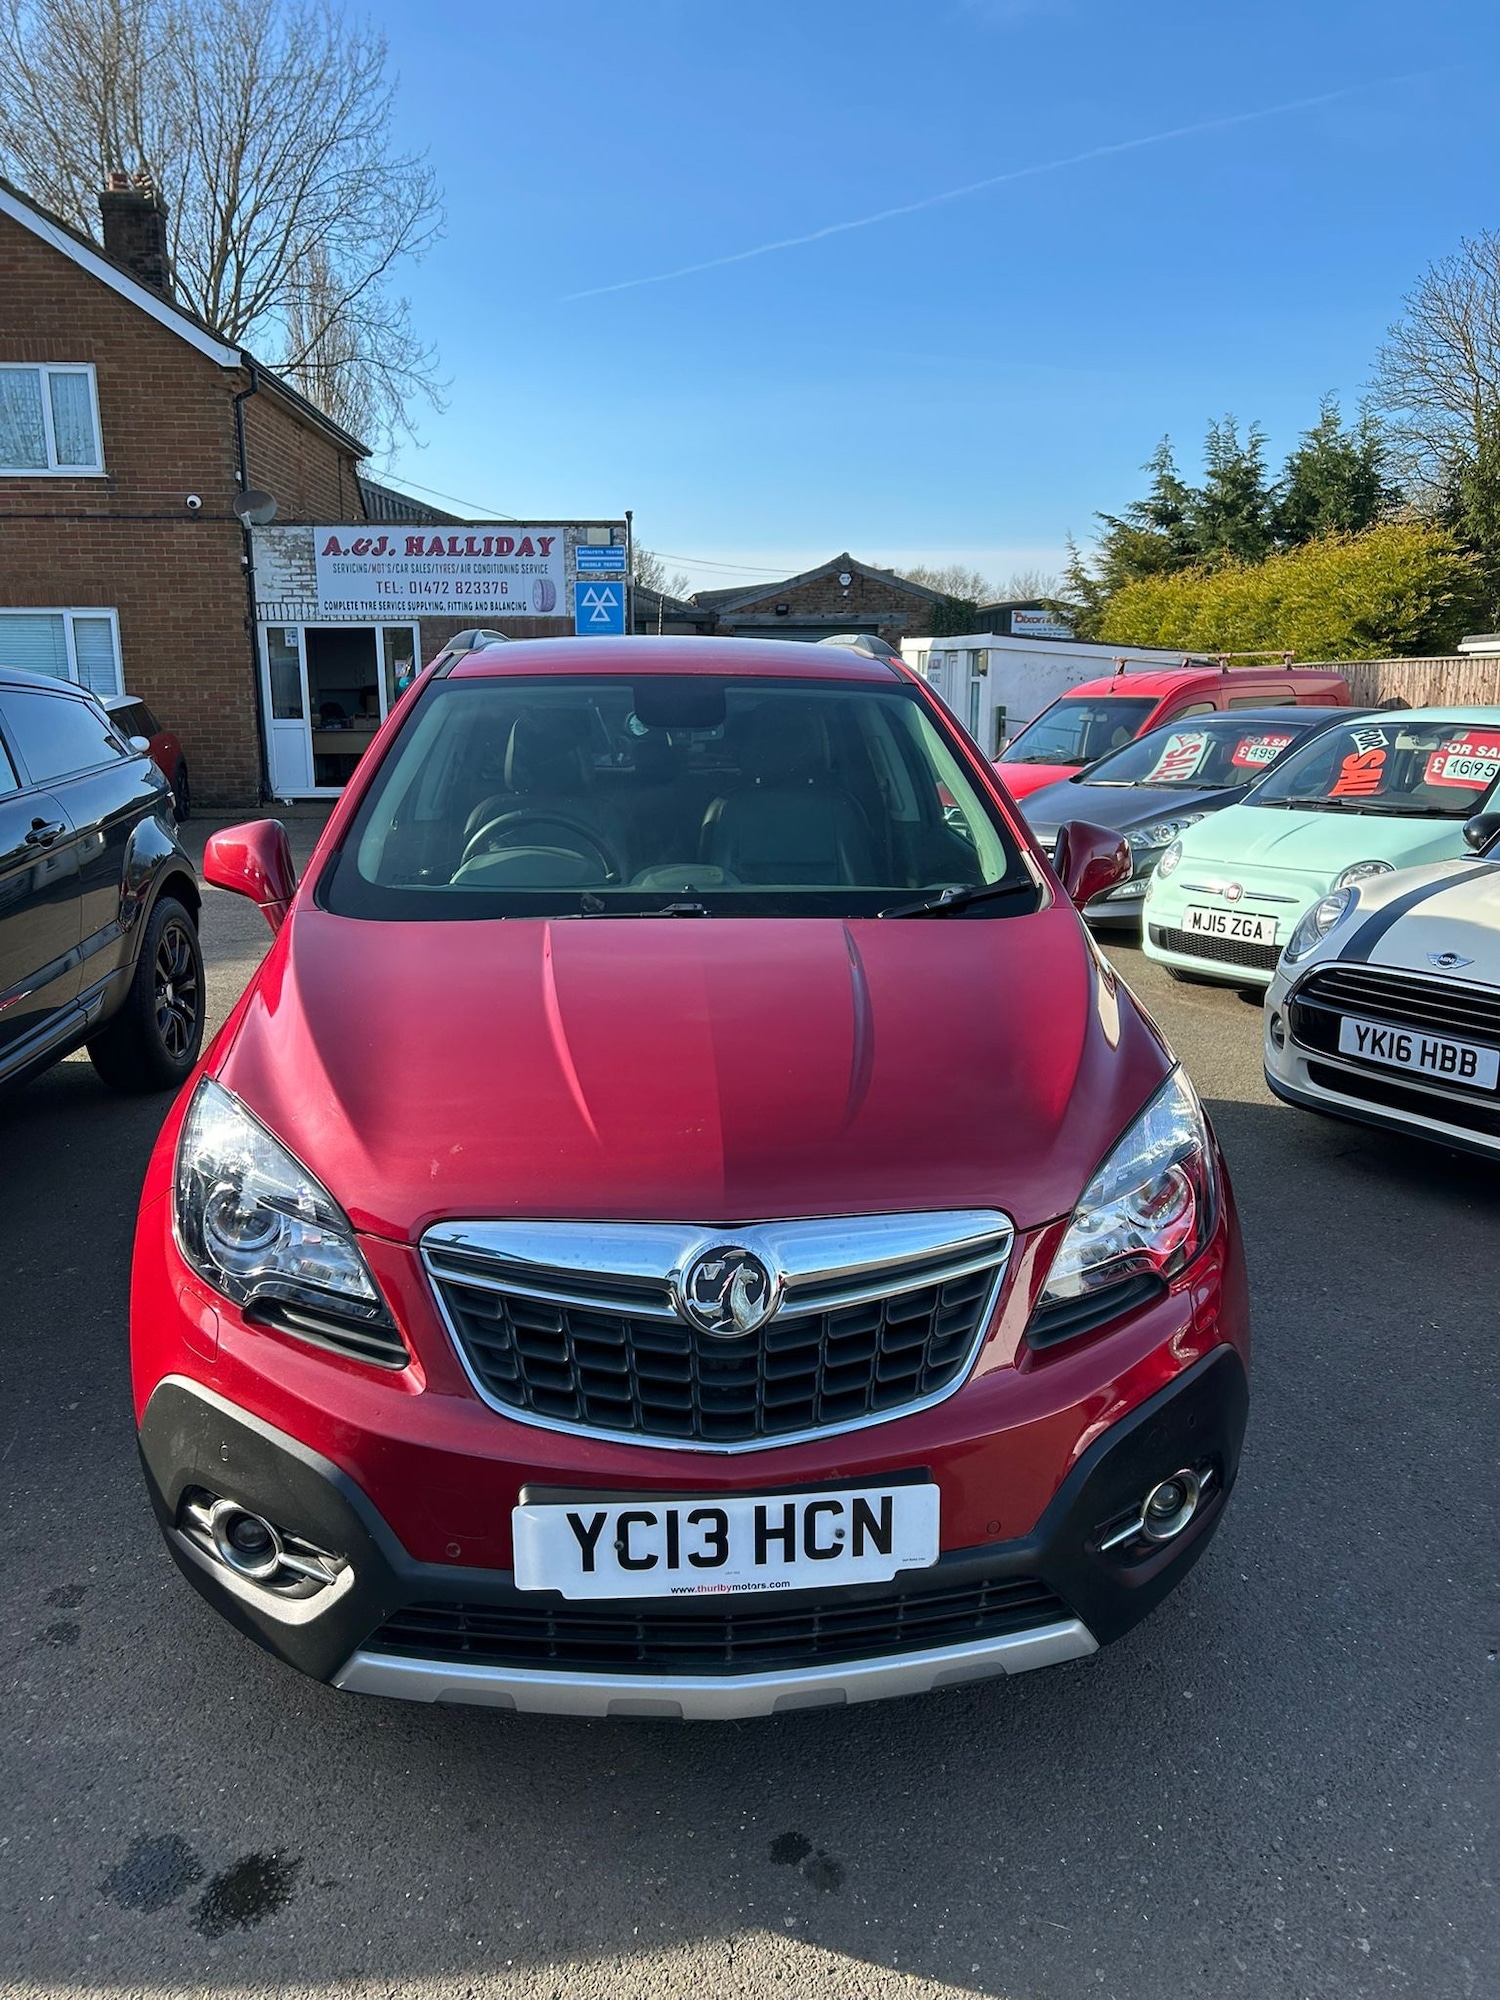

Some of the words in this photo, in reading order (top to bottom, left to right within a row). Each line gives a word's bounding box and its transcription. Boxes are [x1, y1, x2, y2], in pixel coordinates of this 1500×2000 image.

[404, 535, 556, 557] HALLIDAY
[473, 563, 520, 574] CONDITIONING
[521, 563, 549, 574] SERVICE
[376, 581, 404, 594] TEL:
[409, 581, 449, 594] 01472
[455, 581, 508, 594] 823376
[323, 601, 359, 611] COMPLETE
[360, 601, 377, 611] TYRE
[378, 601, 406, 611] SERVICE
[447, 601, 473, 611] FITTING
[474, 602, 488, 611] AND
[489, 602, 527, 611] BALANCING
[1245, 735, 1271, 745] FOR
[1440, 742, 1473, 755] FOR
[1475, 745, 1500, 759] SA
[1192, 912, 1226, 933] MJ15
[1231, 918, 1263, 939] ZGA
[1355, 1025, 1413, 1062] YK16
[1420, 1039, 1478, 1078] HBB
[566, 1507, 729, 1572] YC13
[754, 1495, 893, 1565] HCN
[671, 1580, 791, 1594] www.thurlbymotors.com
